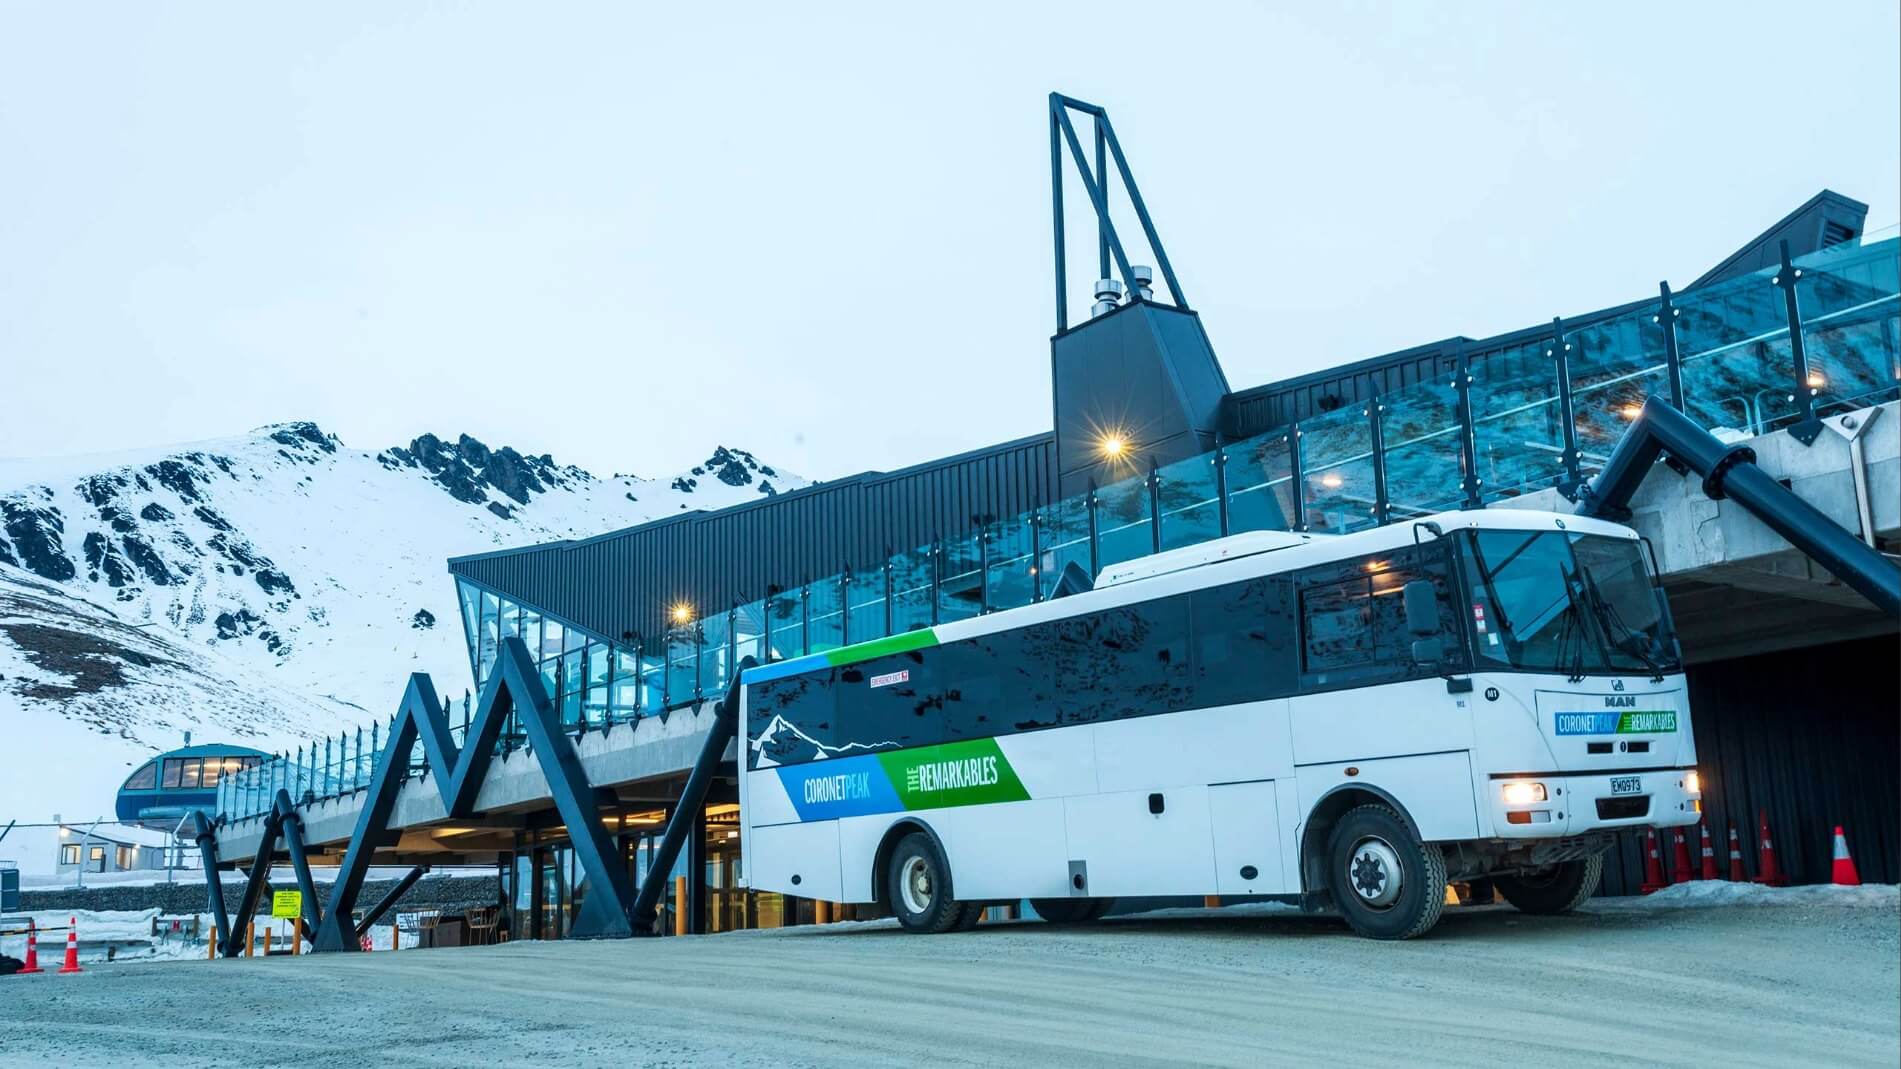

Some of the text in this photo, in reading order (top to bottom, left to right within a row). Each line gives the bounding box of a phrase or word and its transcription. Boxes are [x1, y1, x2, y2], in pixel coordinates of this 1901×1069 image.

[1605, 696, 1636, 707] MAN
[1623, 716, 1632, 730] THE
[1631, 713, 1675, 731] REMARKABLES
[906, 766, 920, 793] THE
[919, 755, 998, 792] REMARKABLES
